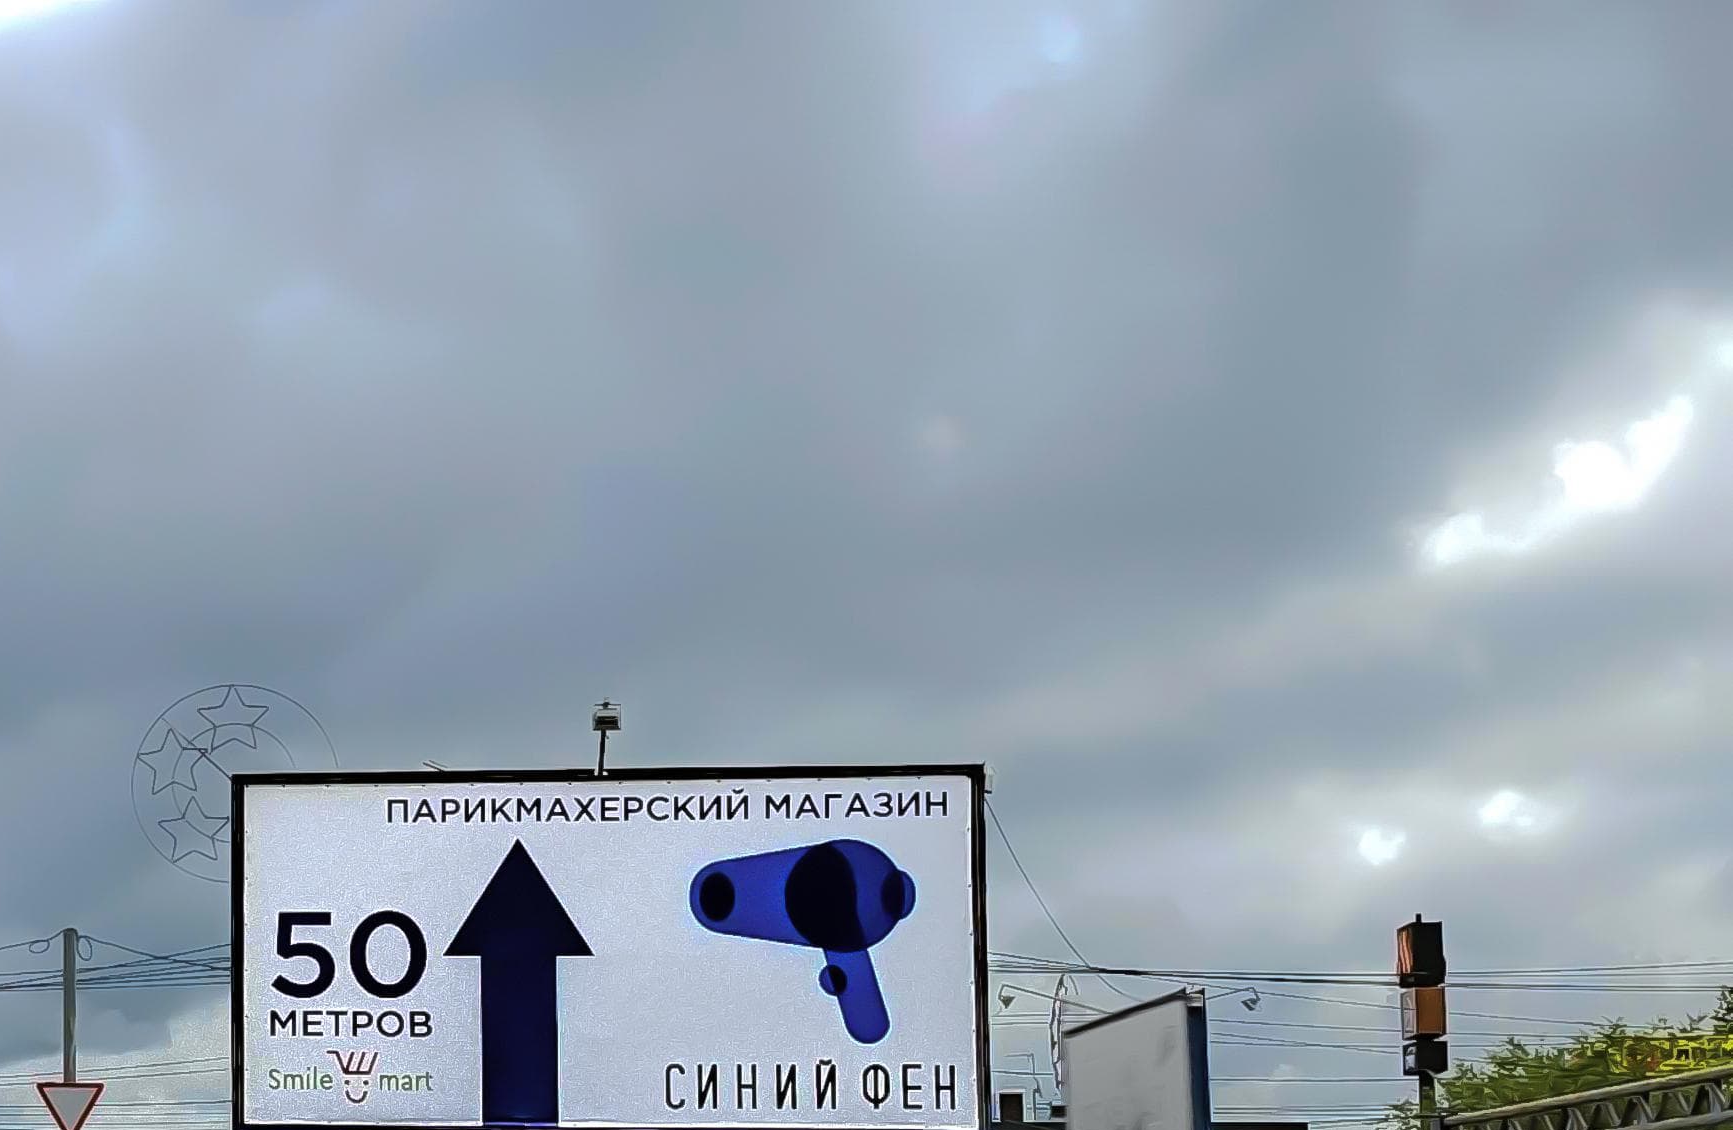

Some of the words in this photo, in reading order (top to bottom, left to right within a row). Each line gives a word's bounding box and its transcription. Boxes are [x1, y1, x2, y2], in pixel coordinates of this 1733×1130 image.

[386, 788, 749, 824] ПАРИКМАХЕРСКИЙ
[765, 791, 949, 820] МАГАЗИН
[270, 910, 427, 999] 50
[269, 1010, 433, 1038] МЕТРОВ
[268, 1066, 334, 1091] Smile
[379, 1072, 434, 1092] mart
[665, 1059, 837, 1110] СИНИЙ
[862, 1063, 957, 1110] ФЕН
